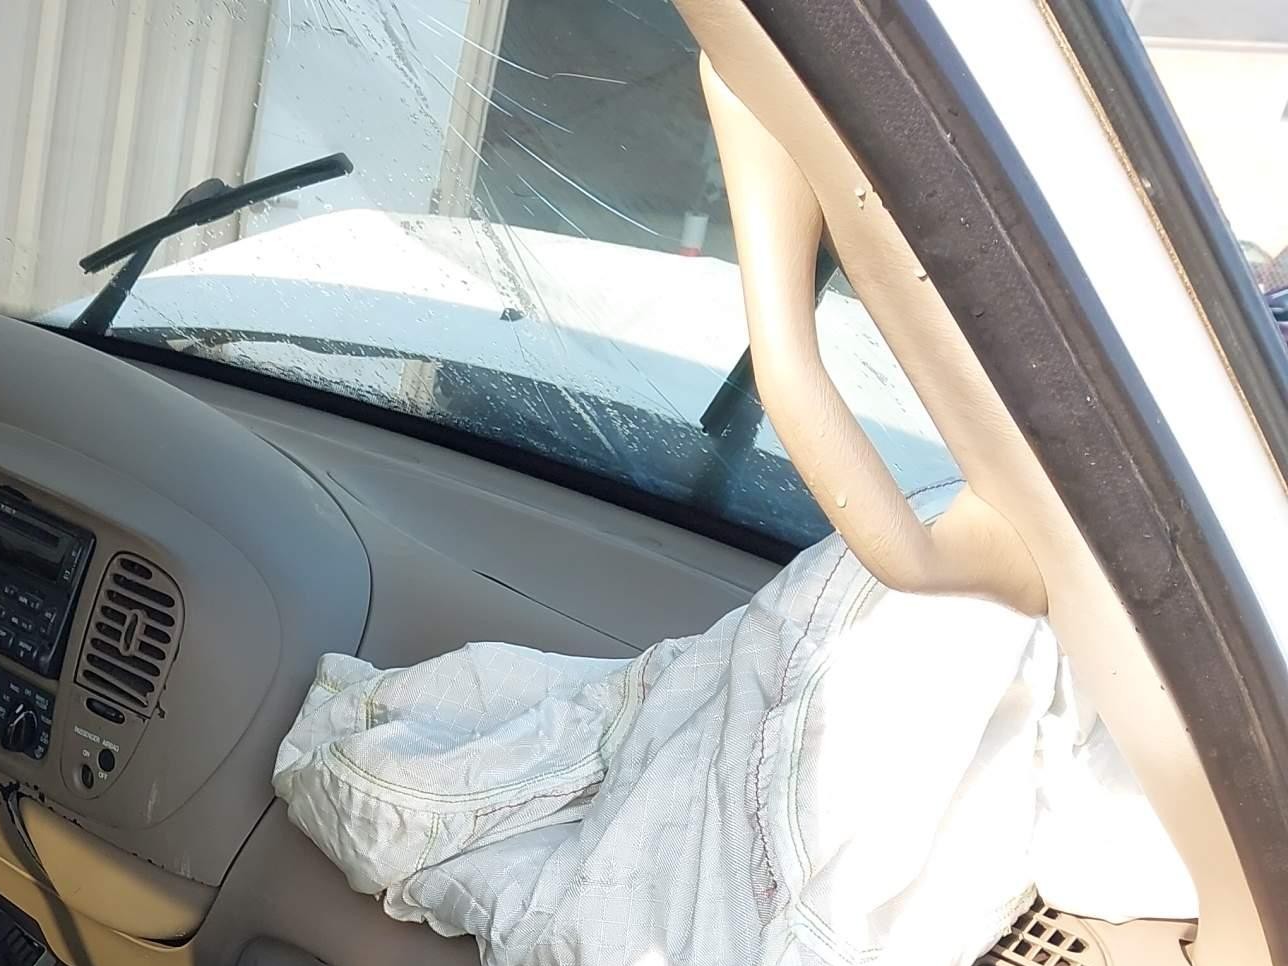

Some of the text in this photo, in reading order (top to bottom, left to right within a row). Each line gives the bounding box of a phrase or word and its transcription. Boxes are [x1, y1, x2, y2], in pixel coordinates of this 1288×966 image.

[74, 725, 120, 753] PASSENGER AIRBAG
[82, 749, 91, 757] ON
[98, 772, 108, 780] OFF
